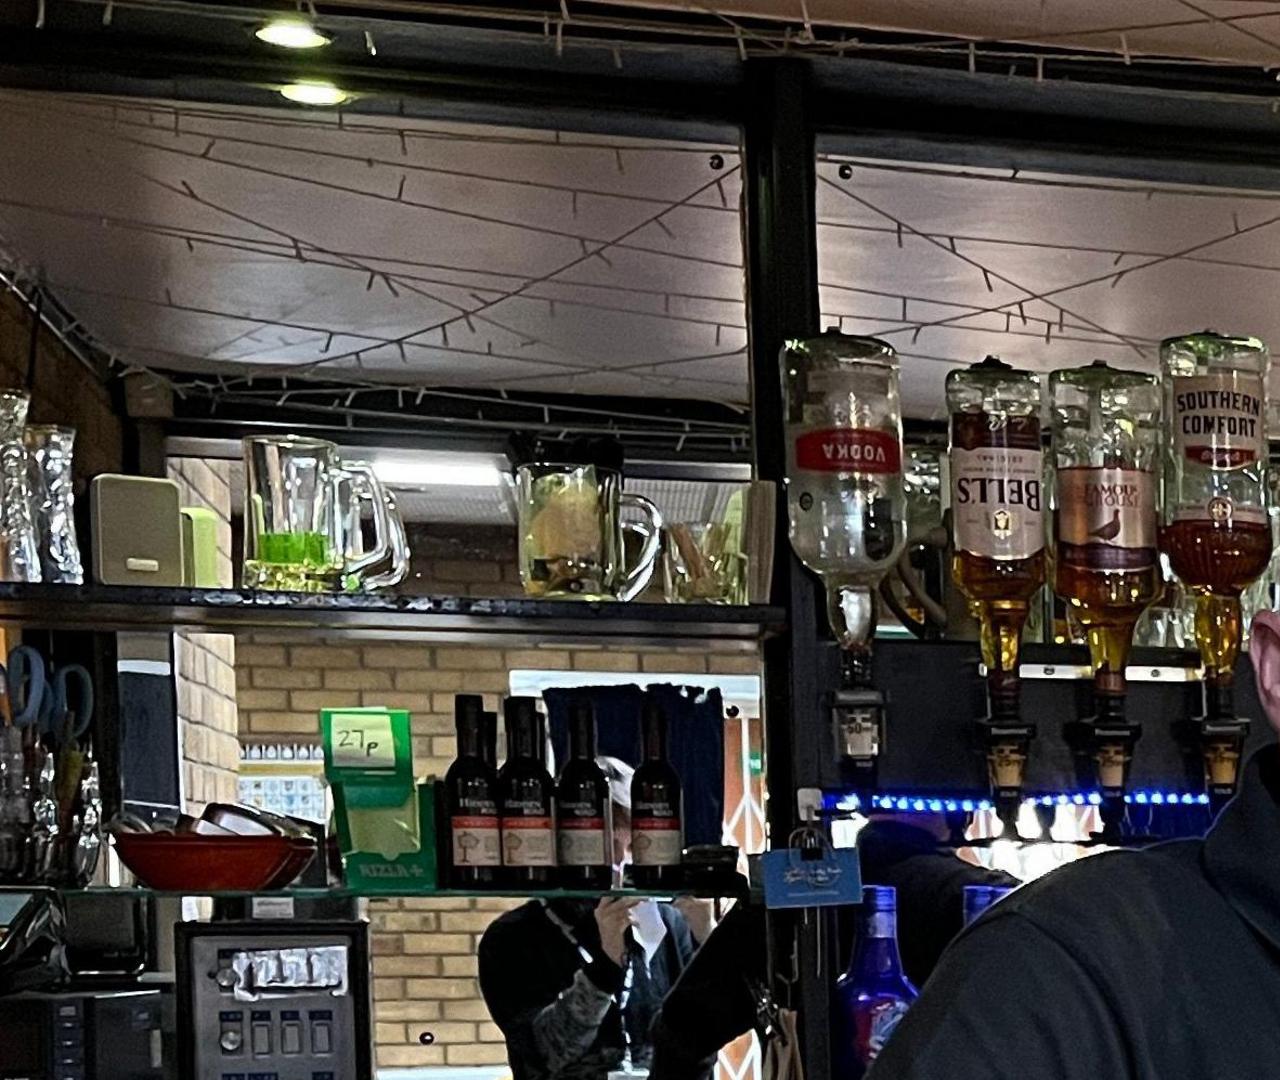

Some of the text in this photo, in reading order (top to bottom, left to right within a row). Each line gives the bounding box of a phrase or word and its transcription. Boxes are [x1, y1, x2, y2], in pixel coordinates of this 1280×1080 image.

[1177, 390, 1259, 416] SOUTHERN
[1182, 415, 1257, 437] COMFORT
[822, 443, 885, 463] VODKA
[957, 477, 1041, 512] BELL'S
